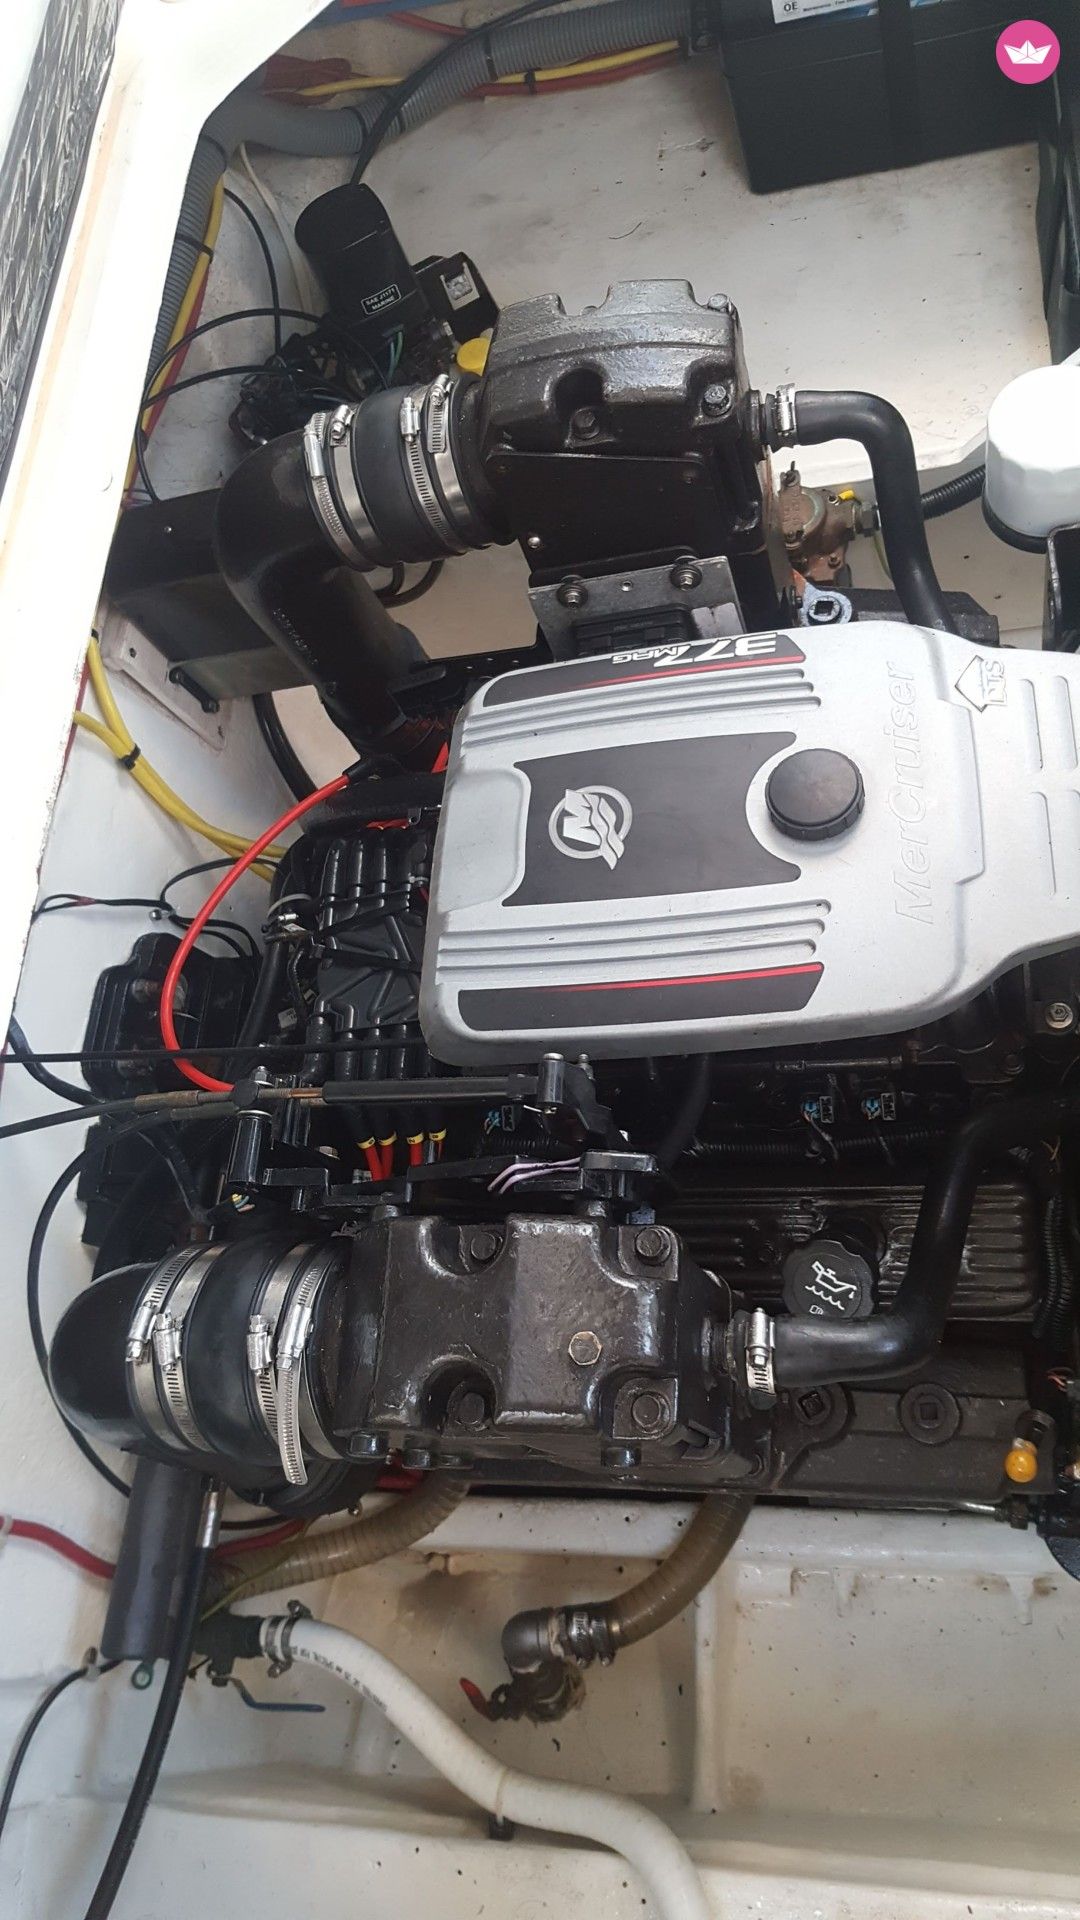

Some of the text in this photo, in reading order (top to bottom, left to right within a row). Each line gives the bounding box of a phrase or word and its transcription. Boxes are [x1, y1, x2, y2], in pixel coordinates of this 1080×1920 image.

[372, 295, 394, 310] MARINE
[612, 632, 778, 668] 377 MAG
[884, 661, 934, 924] MerCruiser
